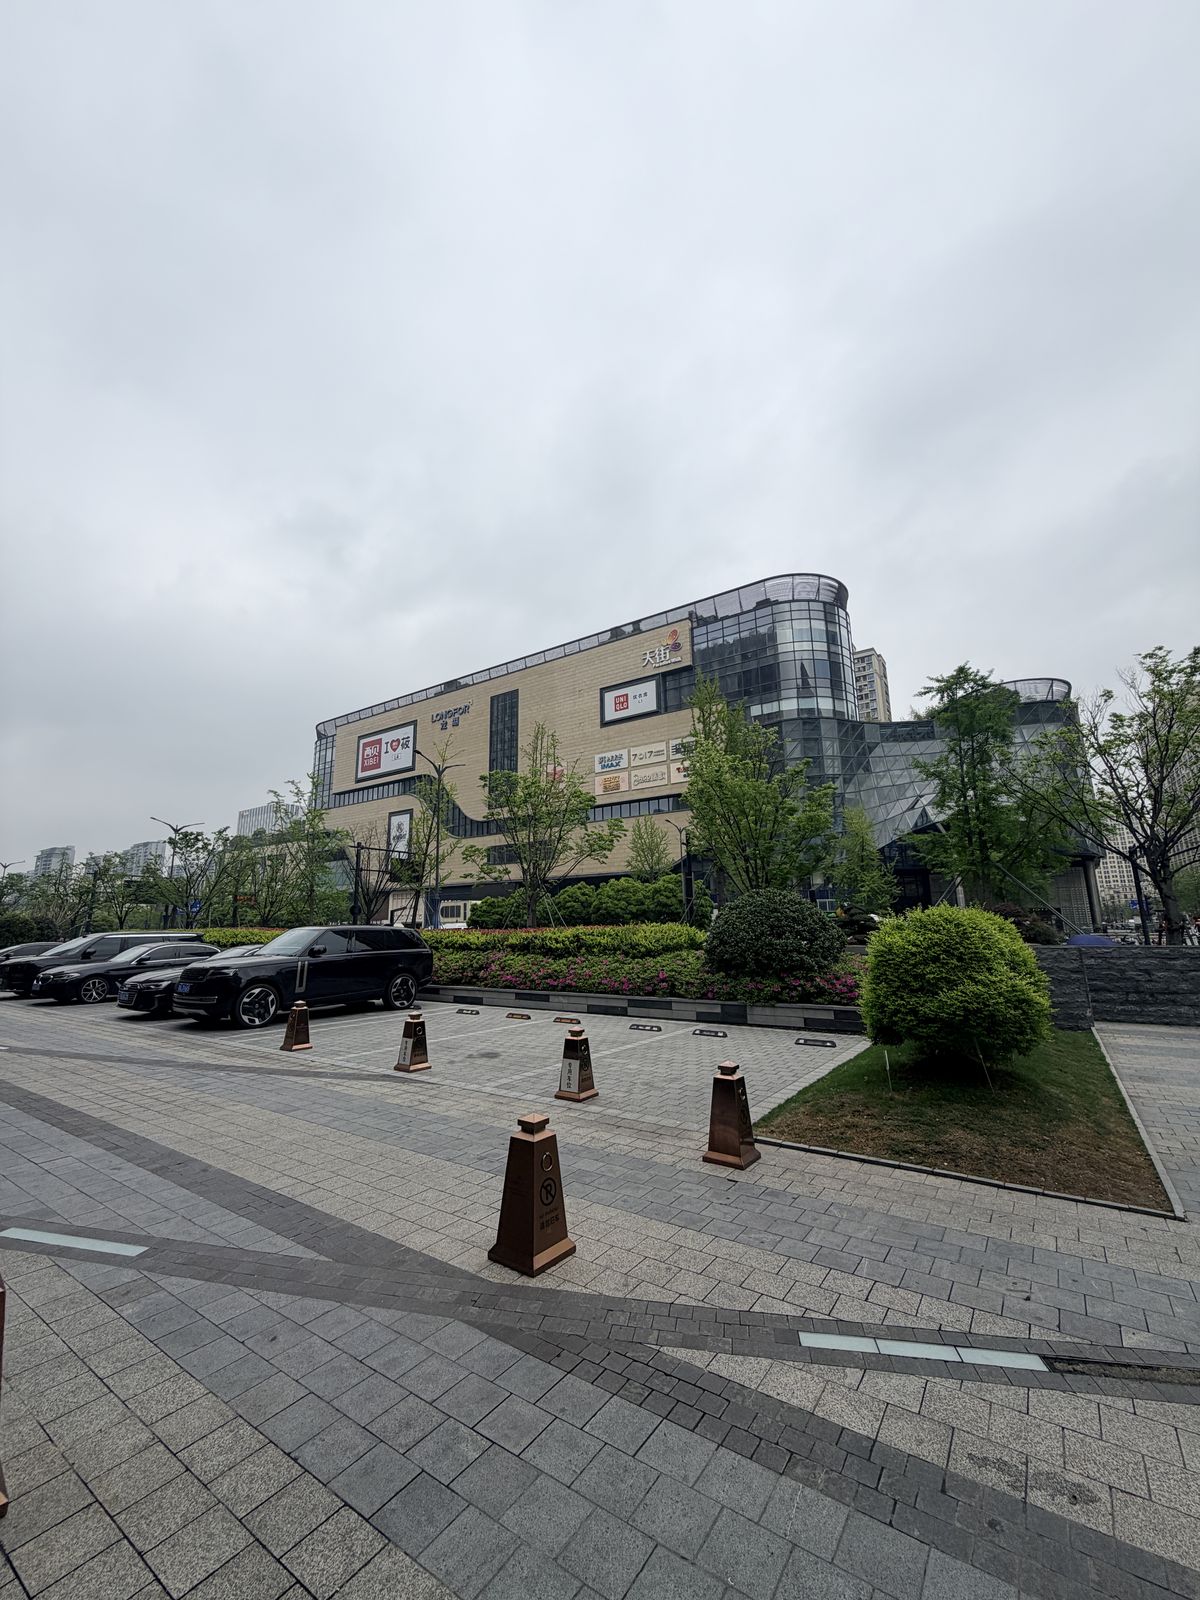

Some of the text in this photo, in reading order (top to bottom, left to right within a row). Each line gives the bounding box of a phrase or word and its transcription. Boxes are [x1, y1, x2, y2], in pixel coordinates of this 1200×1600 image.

[642, 645, 671, 668] 天街
[615, 694, 627, 703] UNI
[615, 702, 628, 711] QLO
[431, 704, 471, 724] LONGFOR
[364, 756, 379, 767] XIBEI
